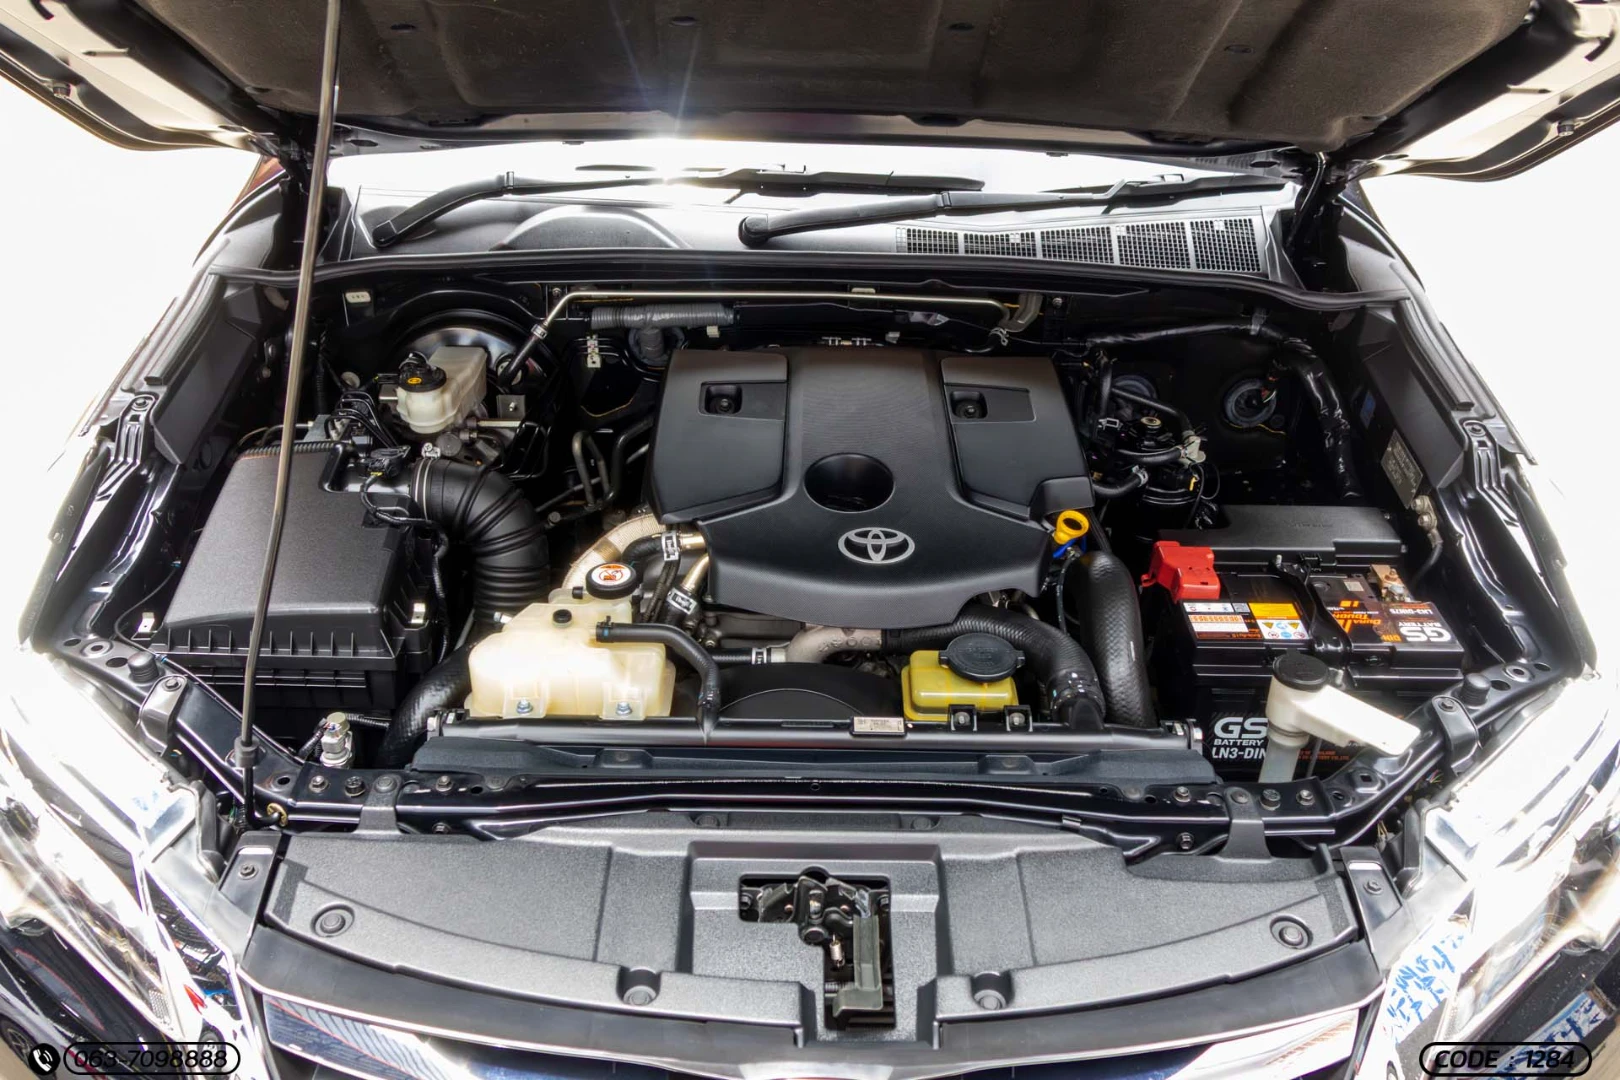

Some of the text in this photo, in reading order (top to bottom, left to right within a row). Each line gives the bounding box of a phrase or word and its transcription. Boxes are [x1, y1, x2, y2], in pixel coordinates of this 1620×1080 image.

[1400, 627, 1451, 642] GS
[1213, 716, 1269, 739] GS
[1213, 738, 1265, 746] BATTERY
